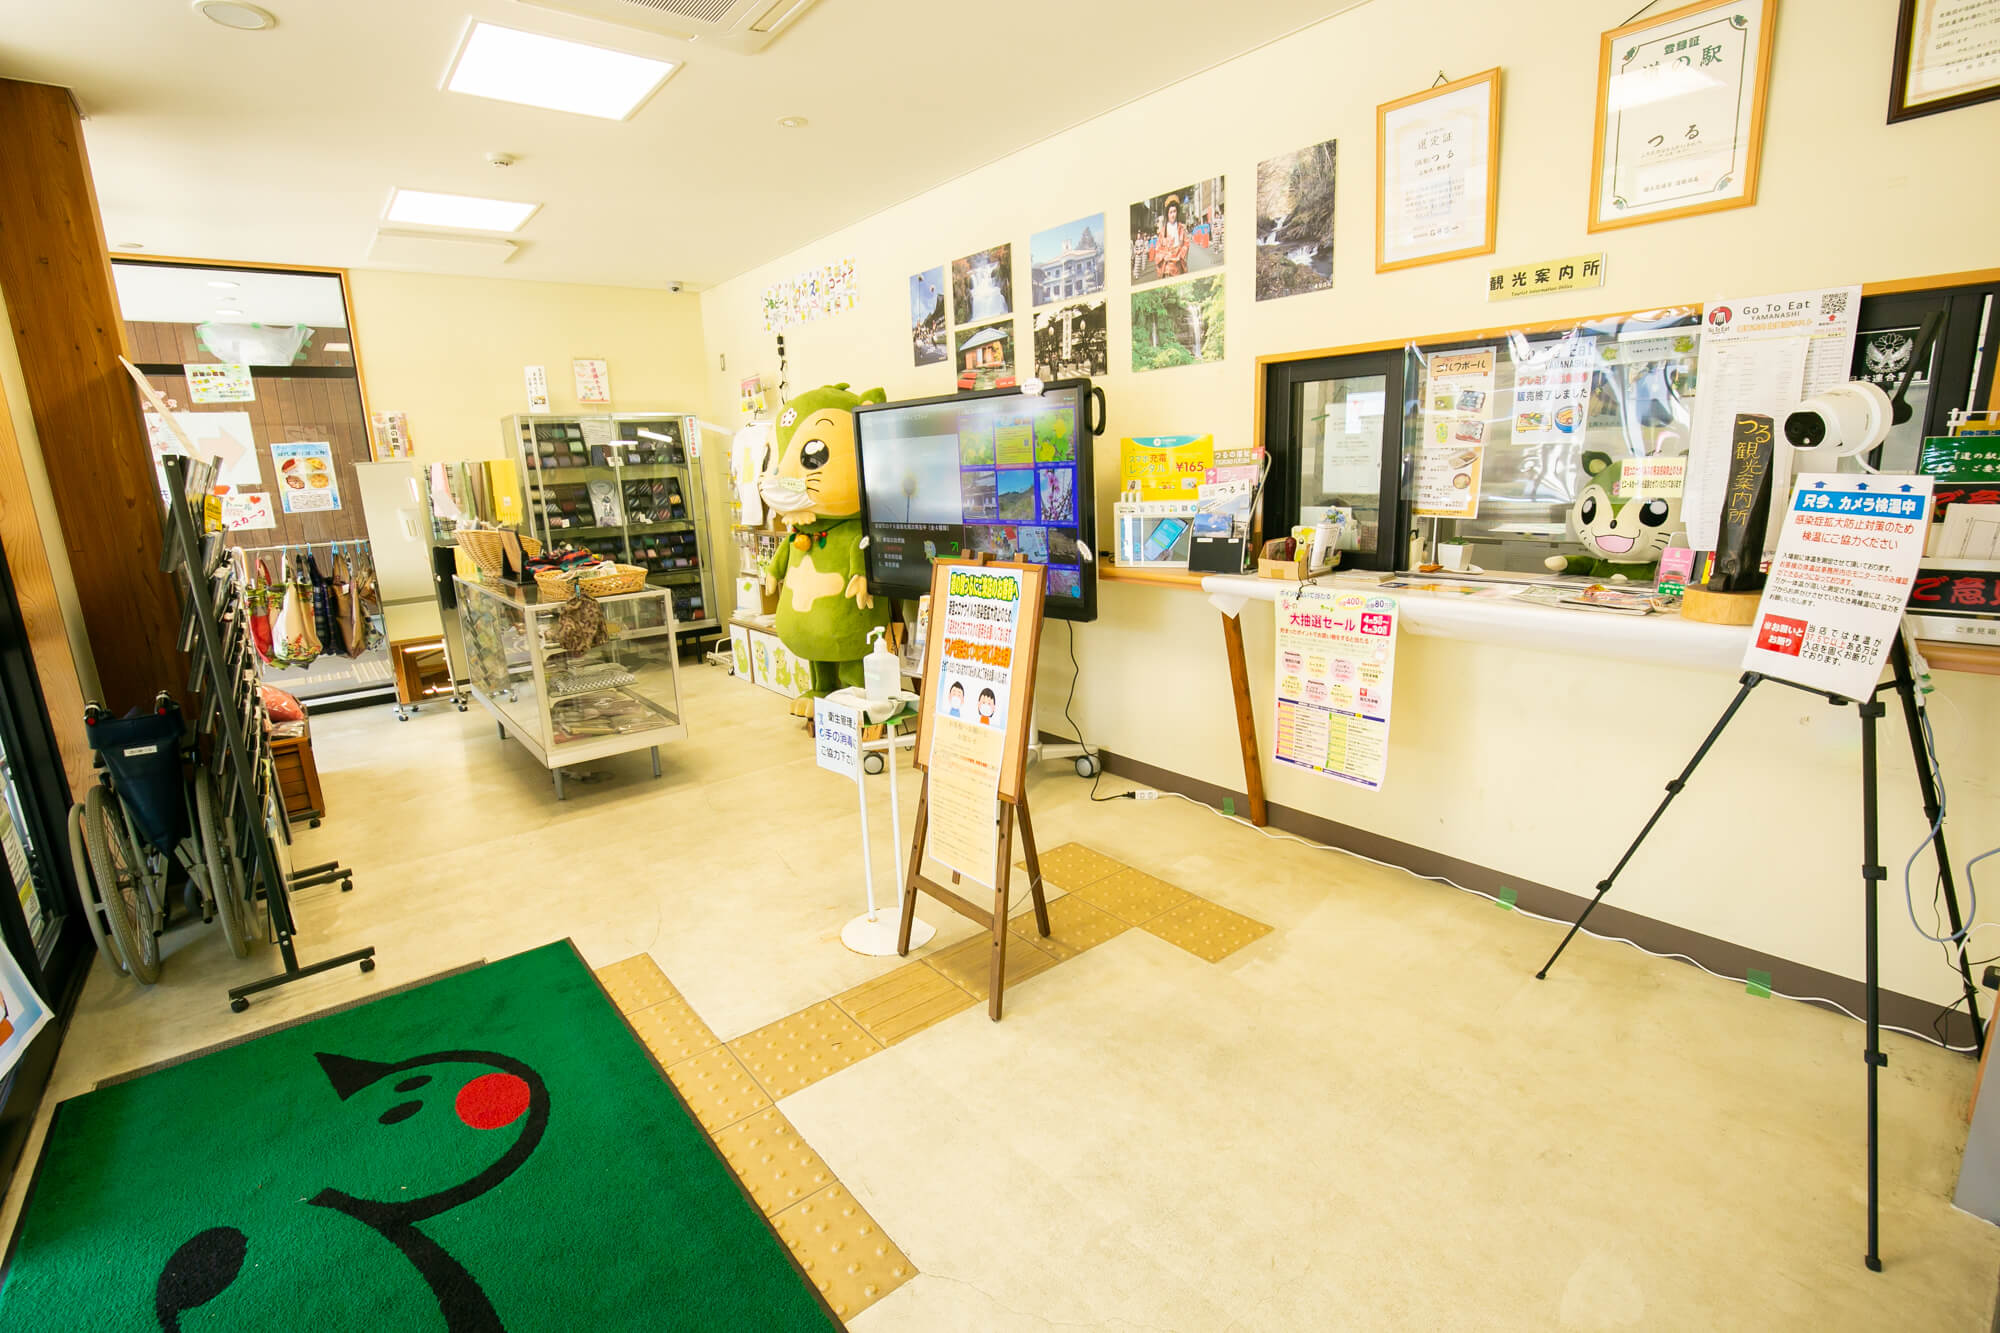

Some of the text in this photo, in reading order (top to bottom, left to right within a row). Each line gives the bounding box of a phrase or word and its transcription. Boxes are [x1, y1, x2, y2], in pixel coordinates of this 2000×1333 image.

[1664, 35, 1701, 54] 登録証
[1490, 259, 1600, 291] 観光案内所
[1743, 300, 1811, 315] Go To Eat
[1751, 311, 1800, 321] YAMANASHI
[1802, 493, 1917, 515] 只今、カメラ検温中
[1794, 514, 1914, 534] 感染症拡大防止対策のため
[1802, 531, 1898, 550] 検温にご協力ください
[1290, 612, 1356, 631] 大抽選セール
[1802, 641, 1875, 666] 入店を固くお断りし
[1802, 650, 1842, 667] ております。
